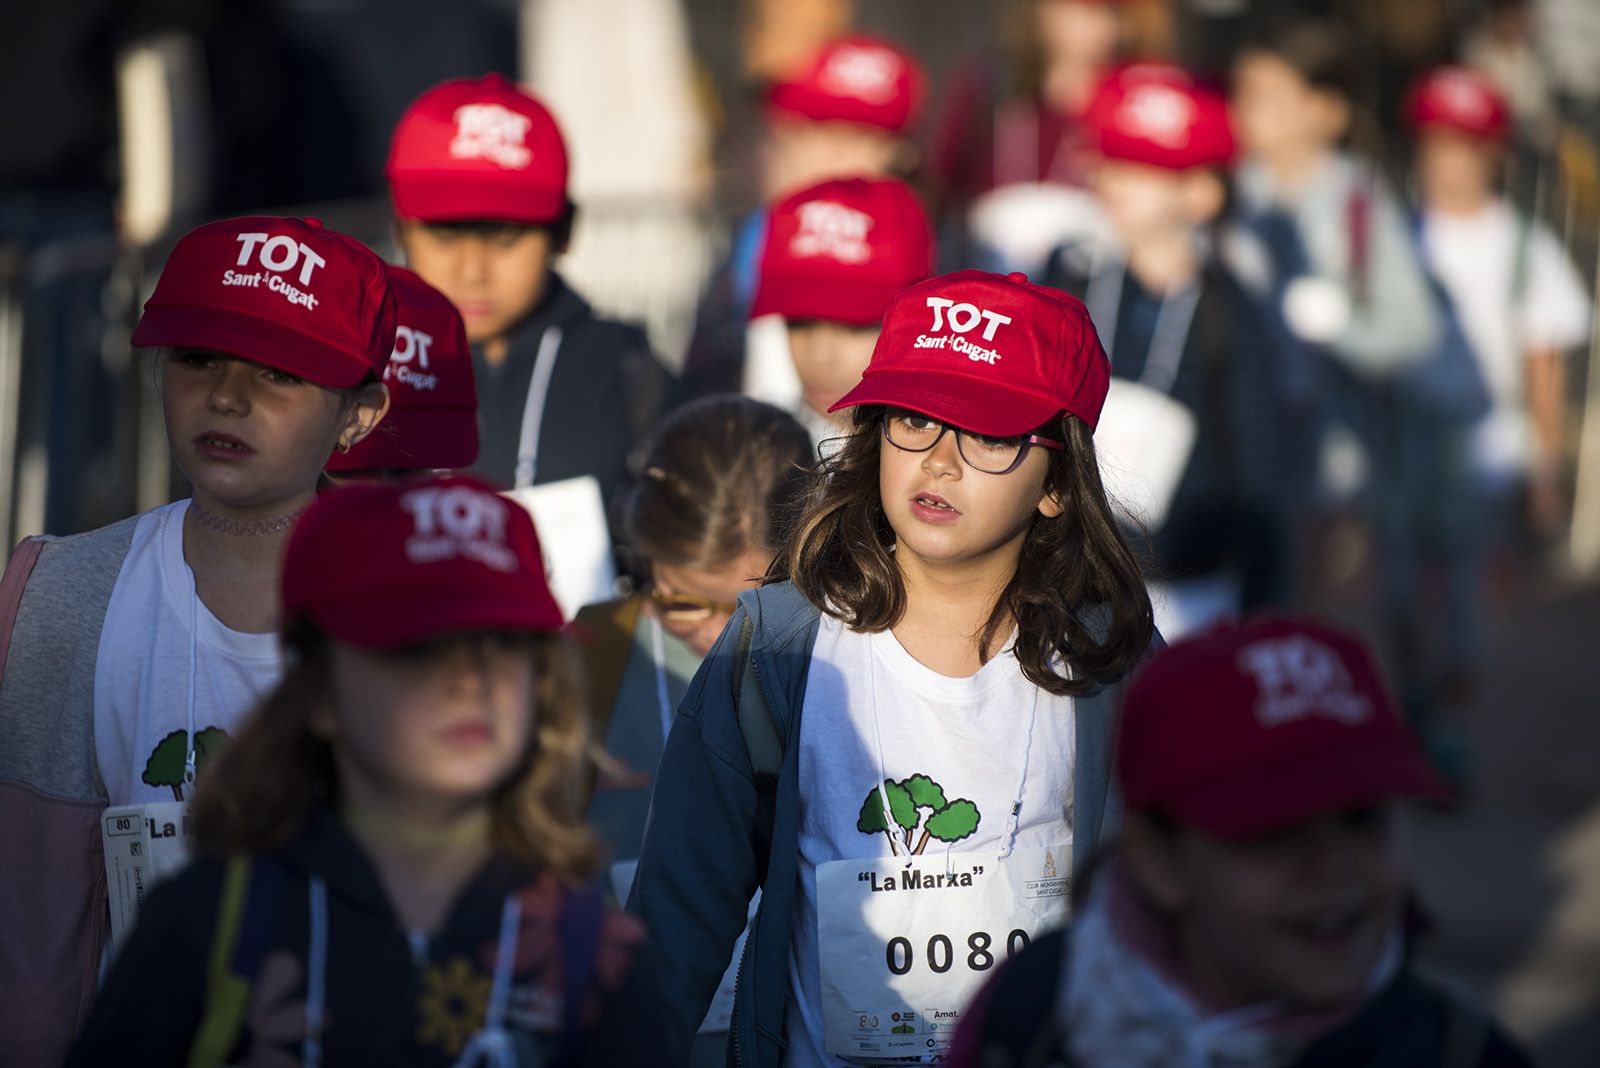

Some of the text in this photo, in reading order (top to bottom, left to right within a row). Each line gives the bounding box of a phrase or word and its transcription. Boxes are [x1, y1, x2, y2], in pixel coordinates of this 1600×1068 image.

[236, 233, 326, 287] TOT
[222, 269, 318, 311] Sant Cugat
[926, 297, 1012, 342] TOT
[390, 325, 433, 369] OT
[914, 334, 1001, 365] Sant Cugat
[116, 818, 130, 830] 80
[858, 871, 897, 892] “La
[934, 1010, 960, 1019] Amat.
